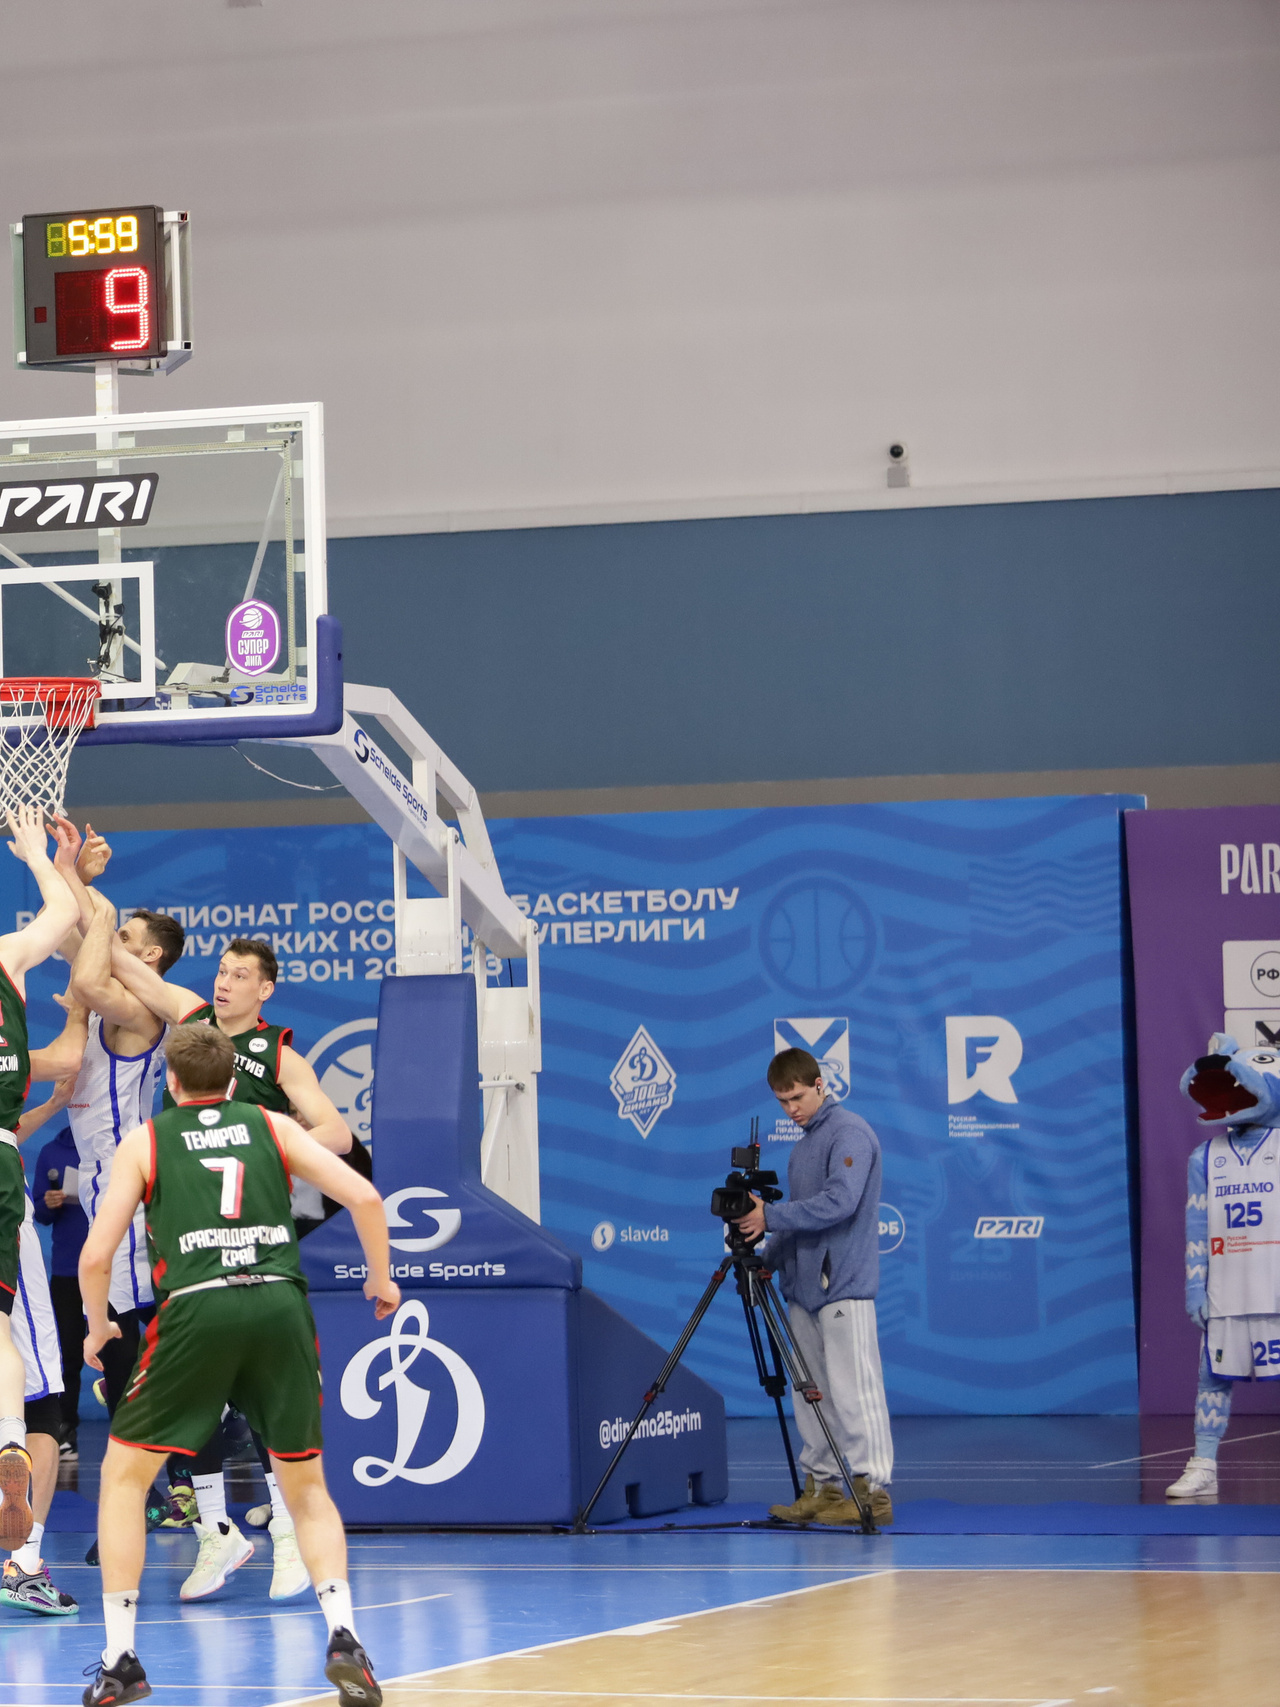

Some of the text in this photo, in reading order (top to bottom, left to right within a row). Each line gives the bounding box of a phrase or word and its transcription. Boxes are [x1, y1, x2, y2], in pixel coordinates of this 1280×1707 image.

[105, 267, 148, 350] 9
[255, 683, 307, 694] Schelde
[255, 692, 307, 704] Sports
[370, 747, 402, 793] Schelde
[402, 784, 428, 822] Sports
[1221, 843, 1280, 895] PAR
[538, 918, 705, 945] УПЕРЛИГИ
[275, 957, 355, 983] ЕЗОН
[1257, 968, 1280, 981] РФ
[181, 1124, 251, 1151] ТЕМИРОВ
[199, 1157, 245, 1220] 7
[1215, 1181, 1274, 1198] ДИНАМО
[1224, 1201, 1263, 1229] 125
[178, 1225, 291, 1254] КРАСНОДАРСКИЙ
[620, 1224, 669, 1242] slavda
[878, 1221, 899, 1236] ФБ
[977, 1219, 1041, 1236] PARI
[221, 1245, 257, 1267] КРАЙ
[334, 1262, 506, 1281] Schlde Sports
